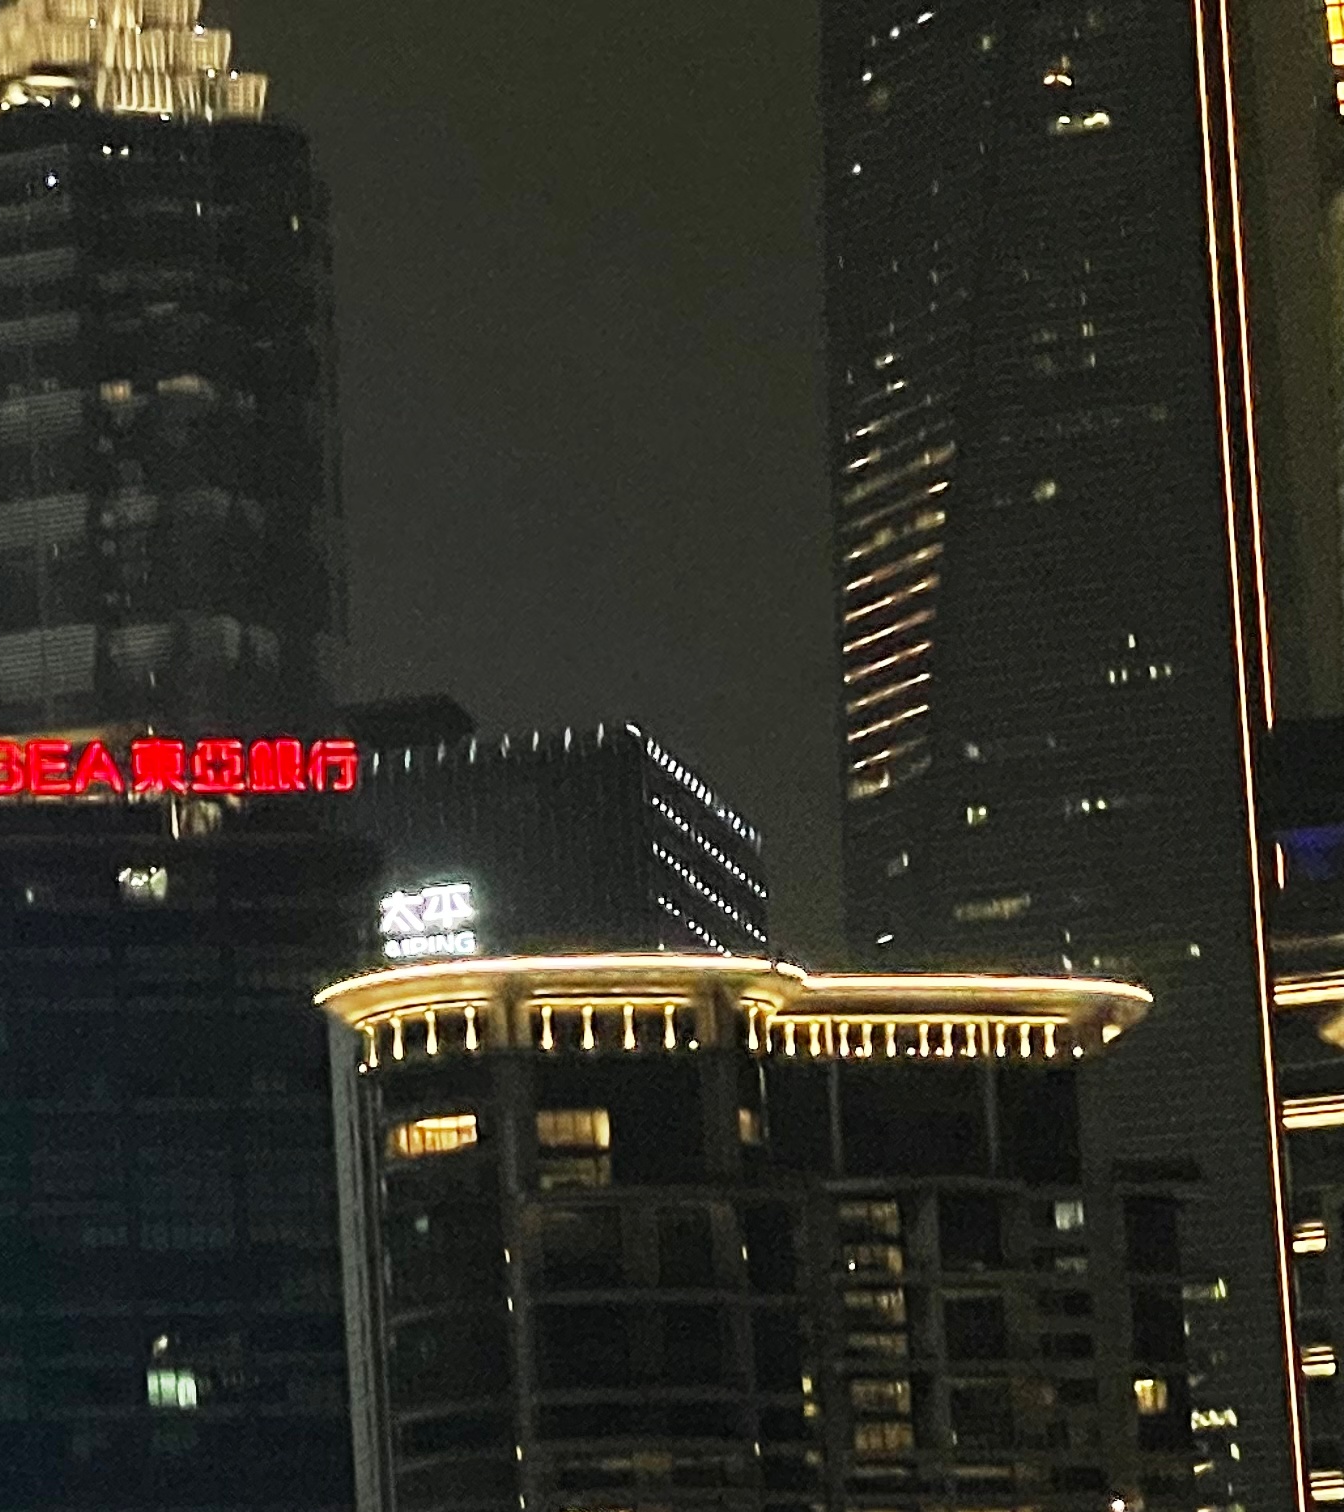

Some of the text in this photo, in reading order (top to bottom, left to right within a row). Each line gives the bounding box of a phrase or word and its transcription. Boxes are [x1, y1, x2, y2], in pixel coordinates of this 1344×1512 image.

[130, 738, 359, 795] 東亞銀行
[381, 882, 474, 931] 太平
